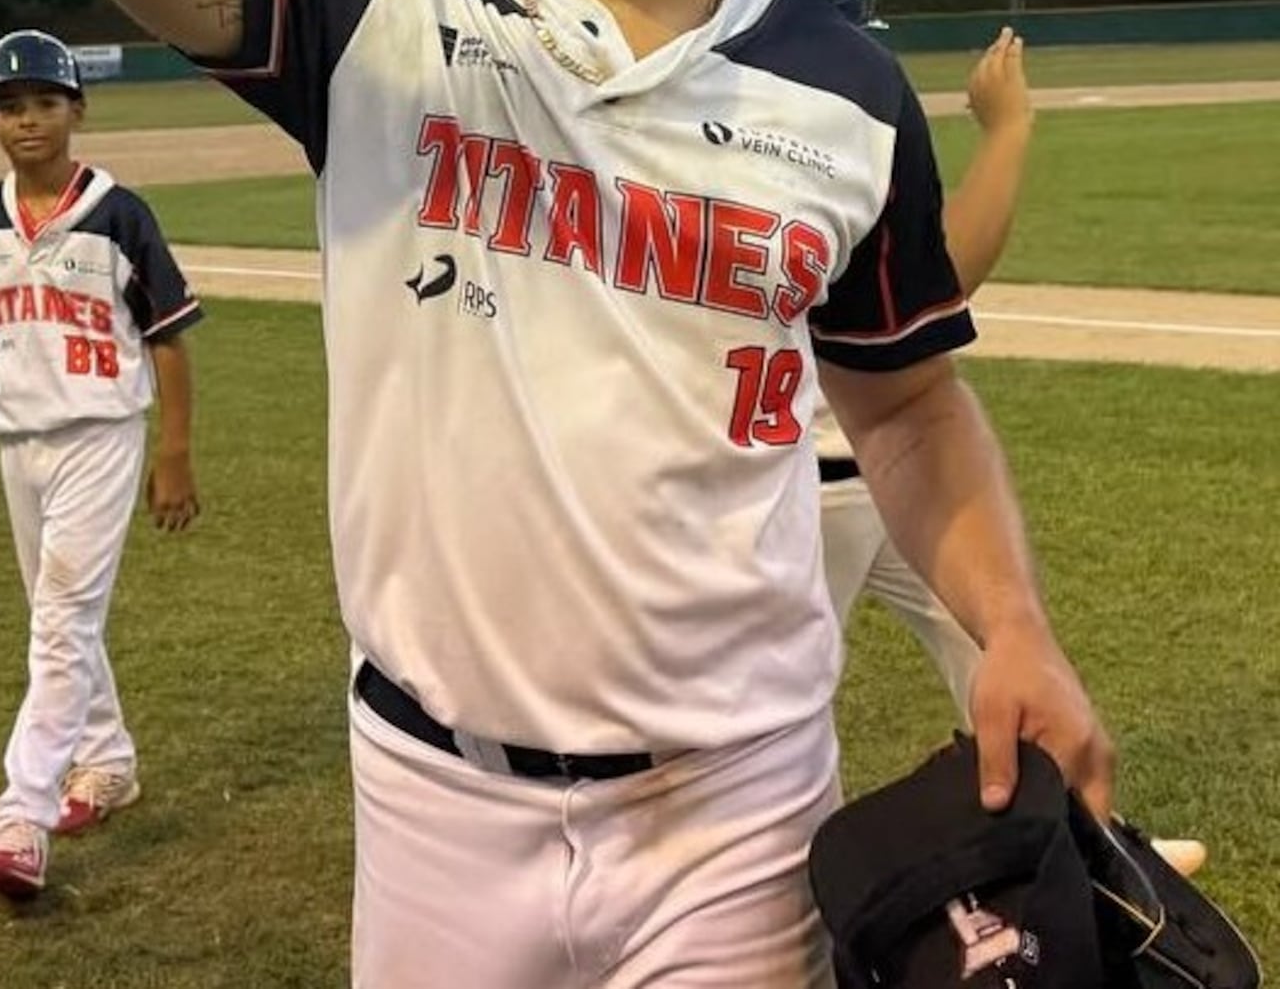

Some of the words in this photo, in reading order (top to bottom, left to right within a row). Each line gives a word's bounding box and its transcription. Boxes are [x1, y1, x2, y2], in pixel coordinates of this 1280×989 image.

[741, 137, 781, 158] VEIN
[787, 148, 837, 180] CLINIC
[417, 114, 831, 328] TITANES
[726, 345, 804, 448] 19
